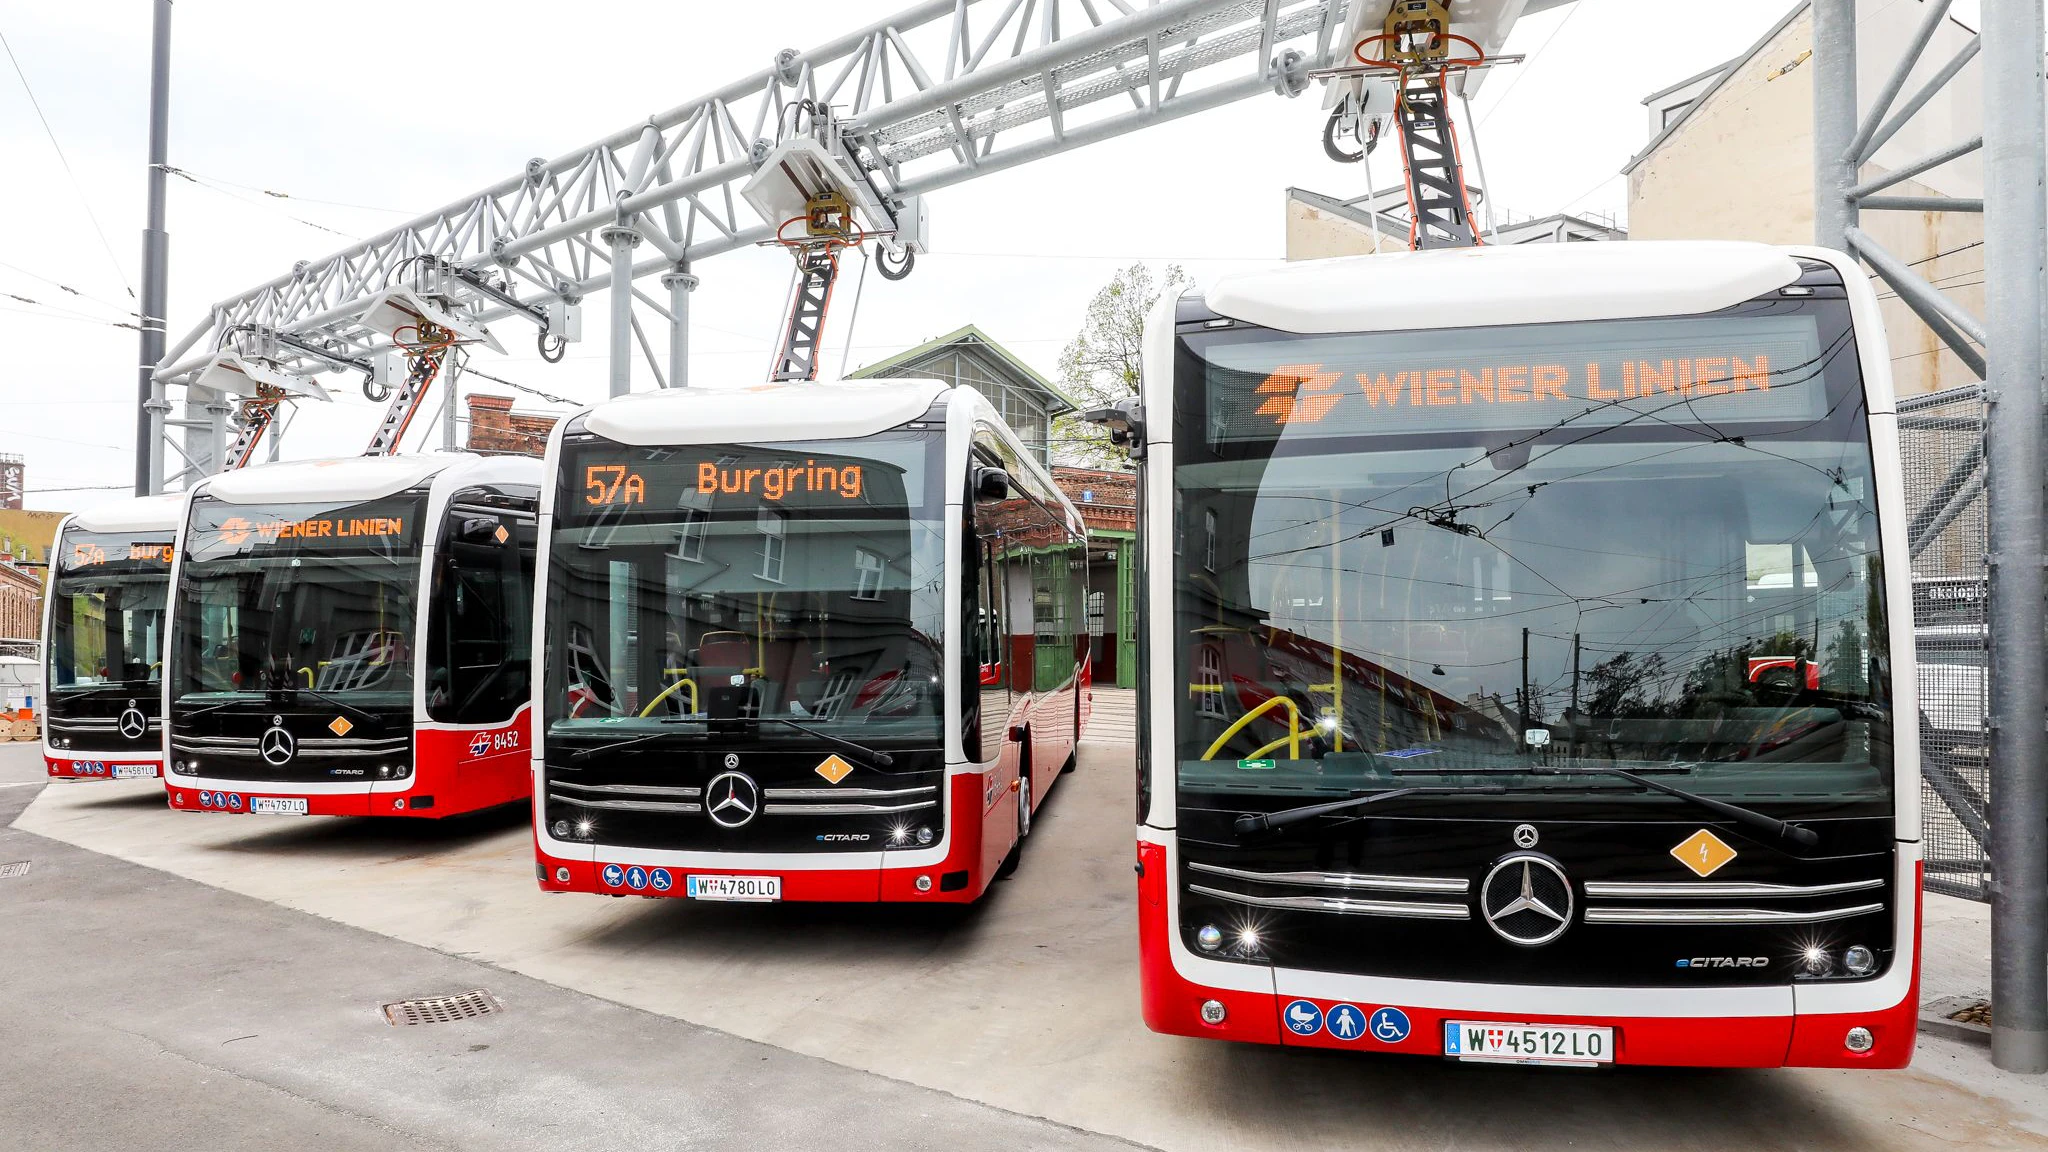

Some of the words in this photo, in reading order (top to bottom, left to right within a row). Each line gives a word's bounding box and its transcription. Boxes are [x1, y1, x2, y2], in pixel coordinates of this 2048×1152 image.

[1355, 364, 1568, 408] WIENER
[1586, 355, 1770, 401] LINIEN
[586, 464, 645, 505] 57A
[698, 459, 861, 500] Burgring
[256, 519, 333, 538] WIENER
[337, 517, 402, 537] LINIEN
[74, 543, 105, 565] 57A
[494, 730, 519, 750] 8452
[1675, 957, 1770, 968] eCITARO
